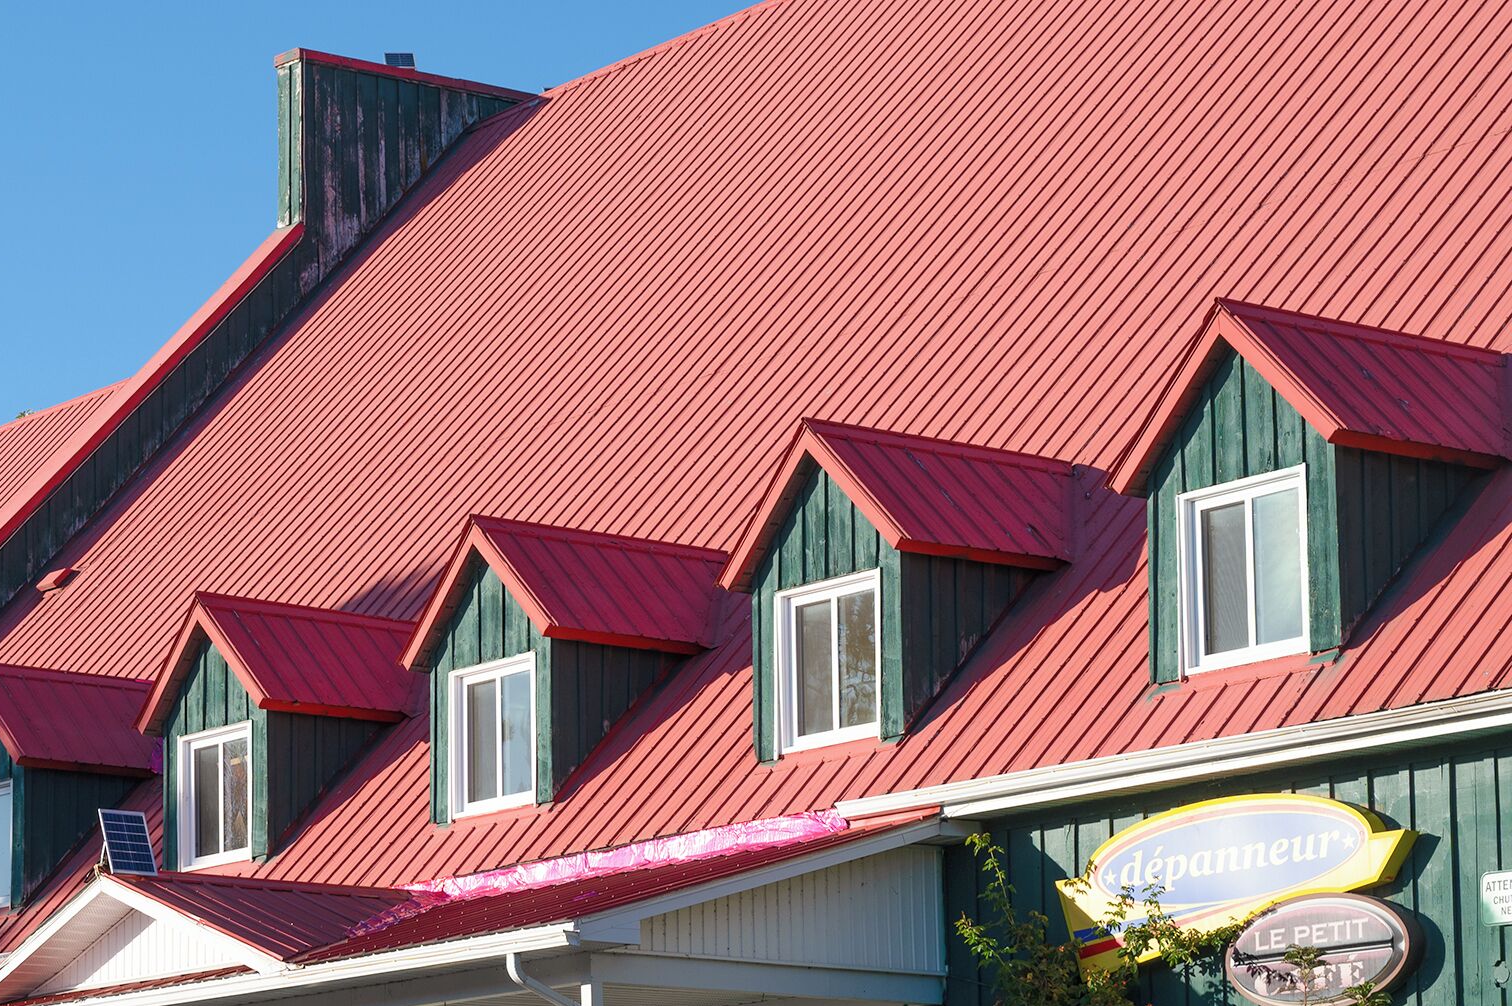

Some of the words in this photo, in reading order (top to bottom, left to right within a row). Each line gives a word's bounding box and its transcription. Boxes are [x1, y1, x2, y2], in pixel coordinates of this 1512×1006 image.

[1119, 830, 1339, 892] dépanneur
[1485, 879, 1512, 892] ATTE
[1254, 928, 1286, 951] LE
[1294, 917, 1369, 945] PETIT
